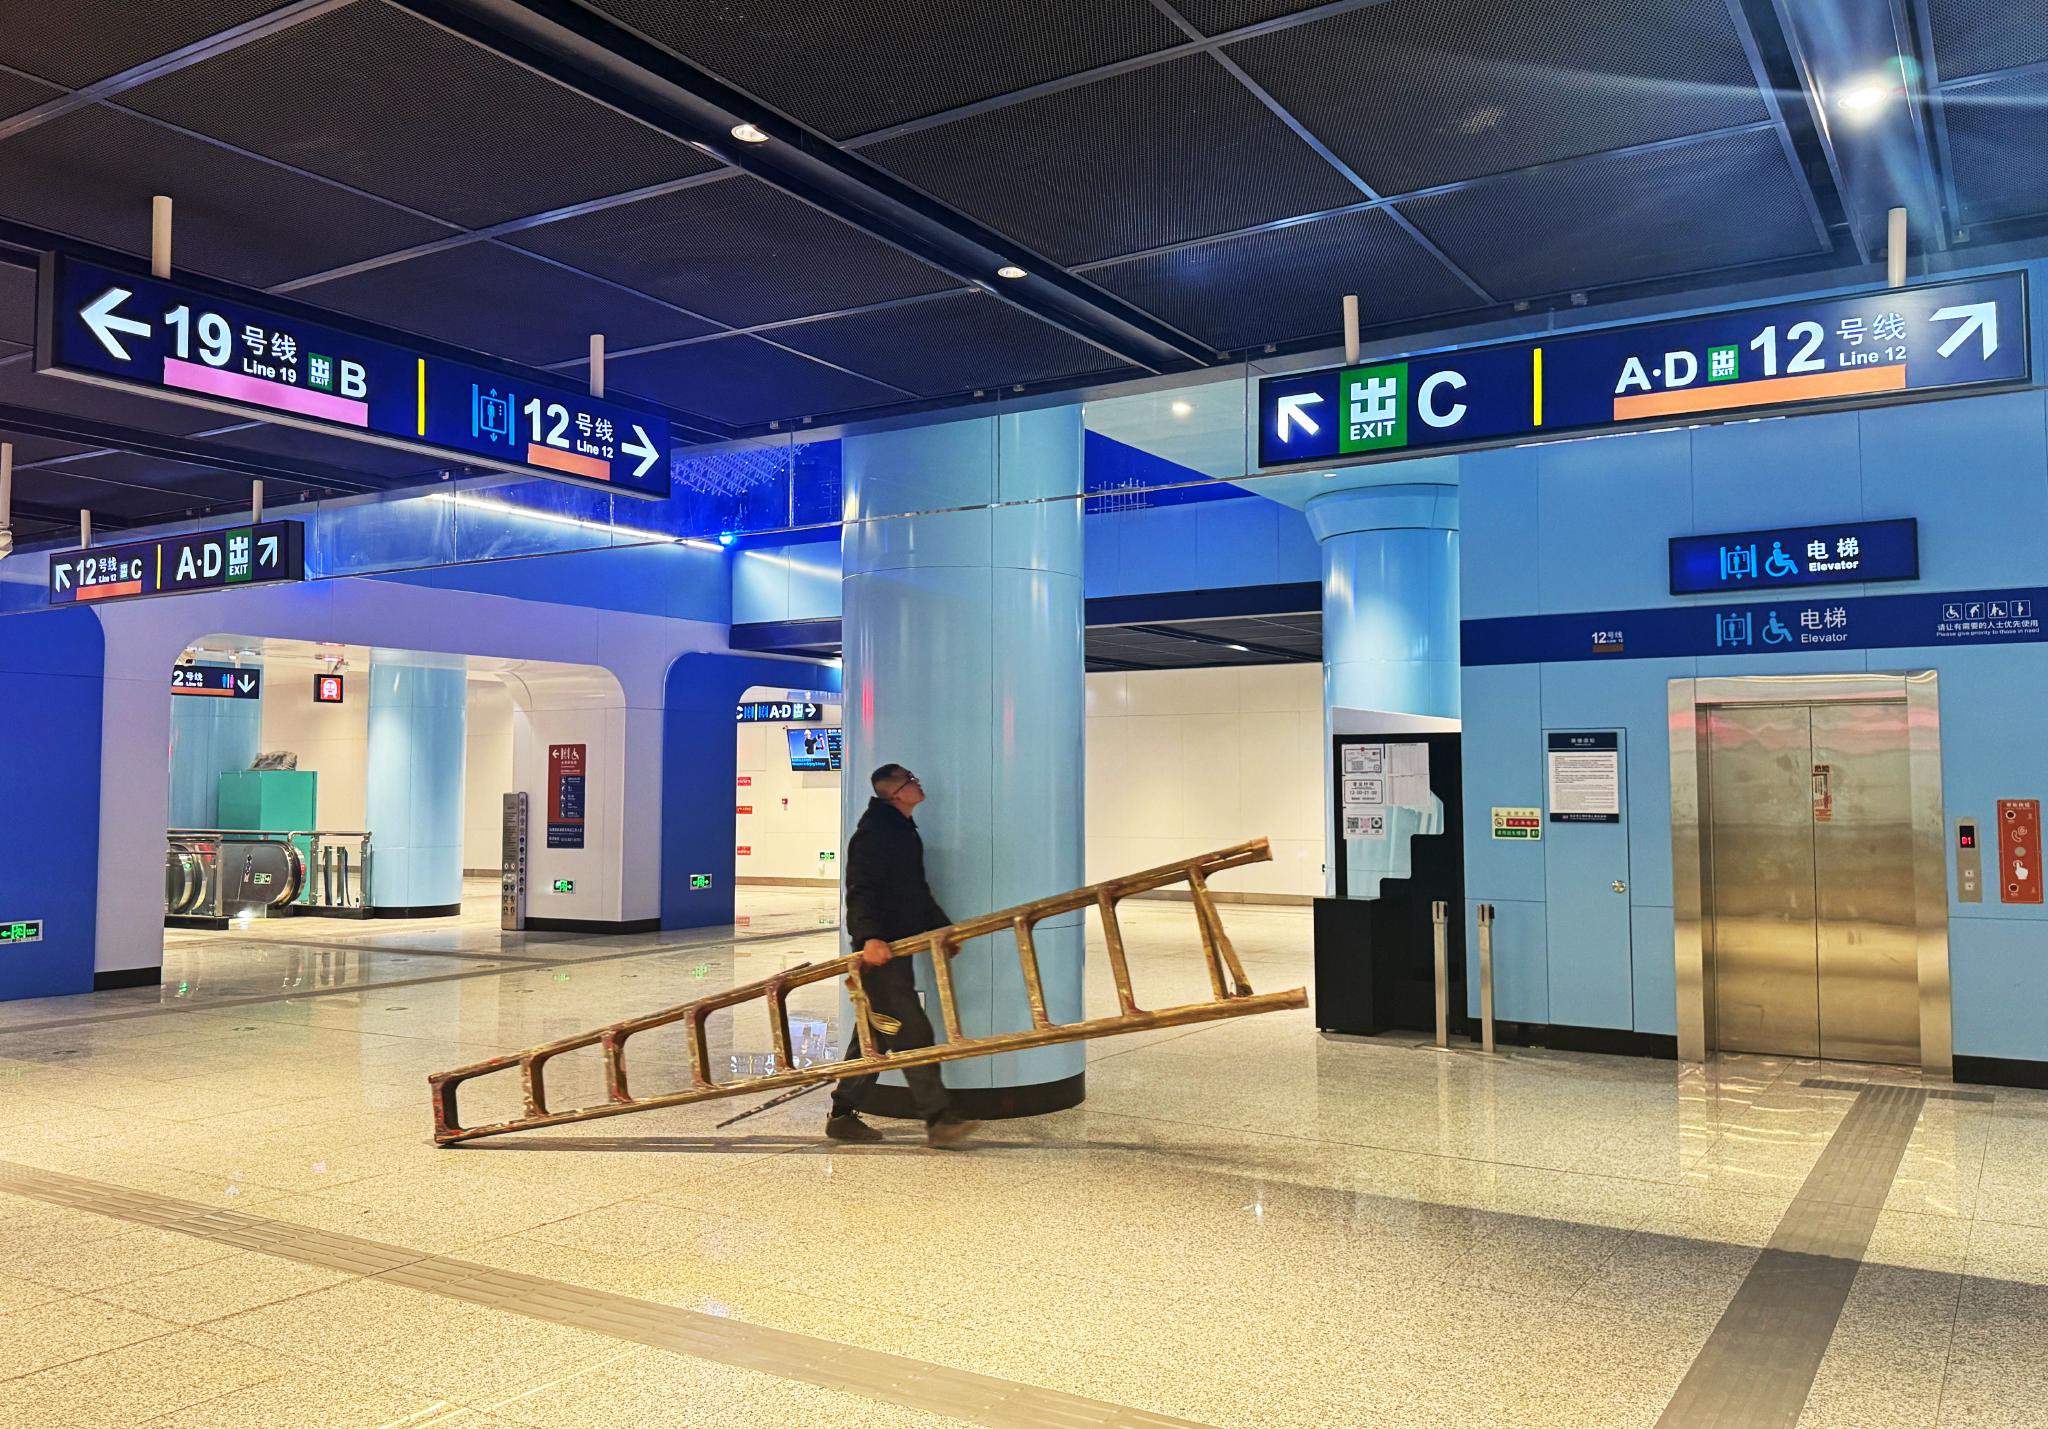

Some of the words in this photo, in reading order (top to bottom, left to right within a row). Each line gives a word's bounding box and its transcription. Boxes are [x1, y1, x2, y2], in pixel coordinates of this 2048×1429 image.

[165, 304, 232, 366] 19
[241, 325, 298, 364] 号线
[341, 359, 367, 398] B
[1750, 321, 1825, 376] 12
[1836, 312, 1907, 346] 号线
[1839, 350, 1879, 367] Line
[1884, 345, 1907, 361] 12
[243, 357, 276, 378] Line
[280, 366, 297, 383] 19
[1712, 366, 1735, 377] EXIT
[311, 376, 329, 387] EXIT
[1418, 370, 1467, 428] C
[524, 398, 570, 449] 12
[575, 412, 614, 443] 号线
[1350, 420, 1396, 440] EXIT
[576, 439, 599, 455] Line
[602, 446, 614, 459] 12
[1807, 537, 1859, 560] 电梯
[76, 558, 97, 586] 12
[131, 558, 142, 579] C
[229, 564, 248, 576] EXIT
[1809, 561, 1859, 572] Elevator
[1801, 606, 1847, 629] 电梯
[1592, 631, 1606, 644] 12
[1801, 633, 1848, 643] Elevator
